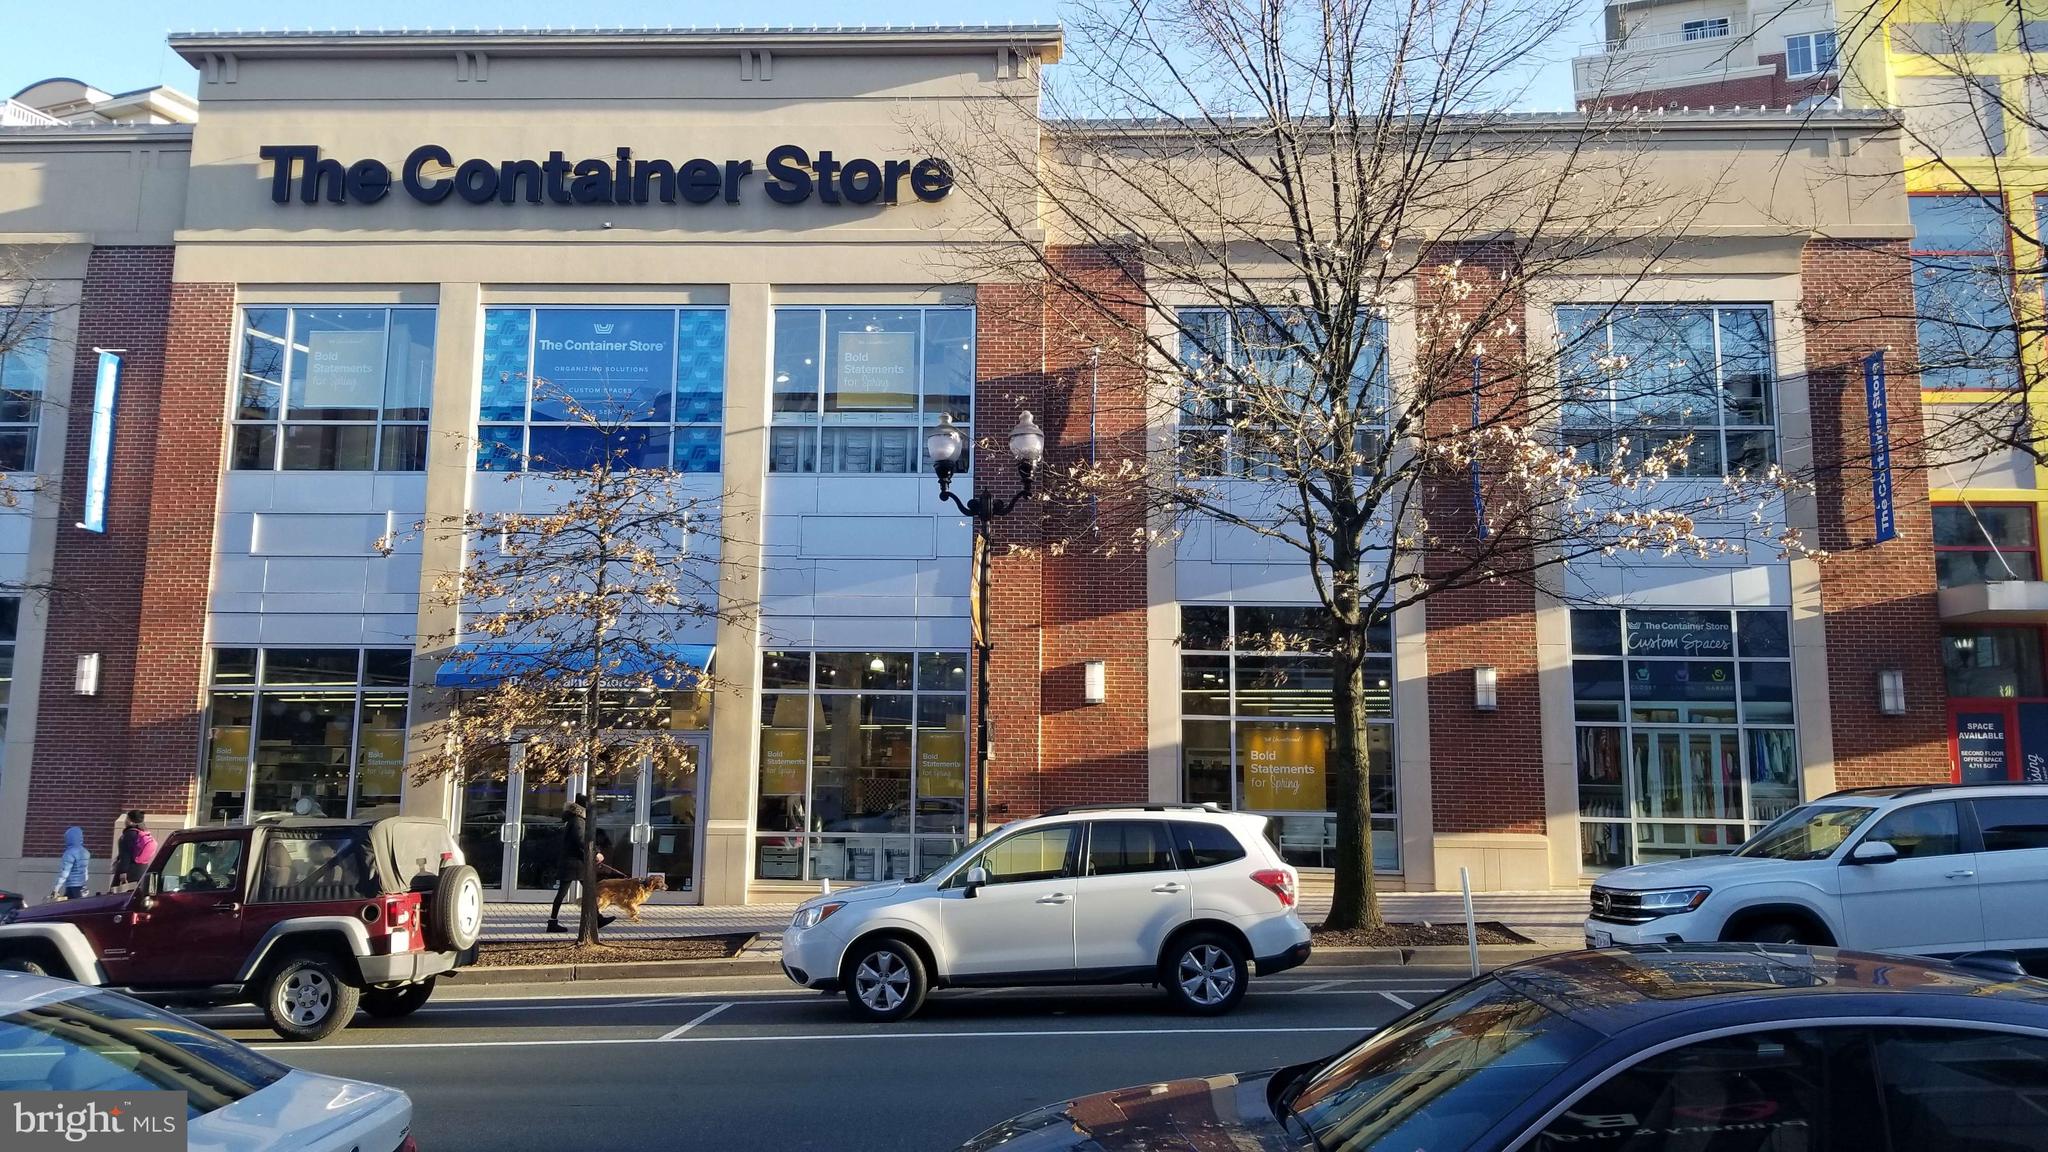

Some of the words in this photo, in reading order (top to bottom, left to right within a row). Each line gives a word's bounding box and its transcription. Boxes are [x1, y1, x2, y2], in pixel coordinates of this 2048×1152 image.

[260, 144, 391, 205] The
[402, 144, 753, 206] Container
[764, 144, 953, 206] Store
[539, 339, 564, 351] The
[565, 339, 627, 351] Container
[629, 340, 664, 352] Store
[314, 351, 338, 361] Bold
[844, 352, 869, 362] Bold
[313, 363, 373, 373] Statements
[844, 364, 905, 374] Statements
[1644, 622, 1660, 630] The
[1661, 622, 1704, 630] Container
[1628, 632, 1679, 650] Custom
[1681, 633, 1731, 656] Spaces
[1967, 722, 1995, 730] SPACE
[1959, 732, 2004, 740] AVAILABLE
[1250, 750, 1276, 760] Bold
[1250, 763, 1316, 775] Statements
[1251, 777, 1266, 788] for
[1270, 774, 1300, 796] Spring
